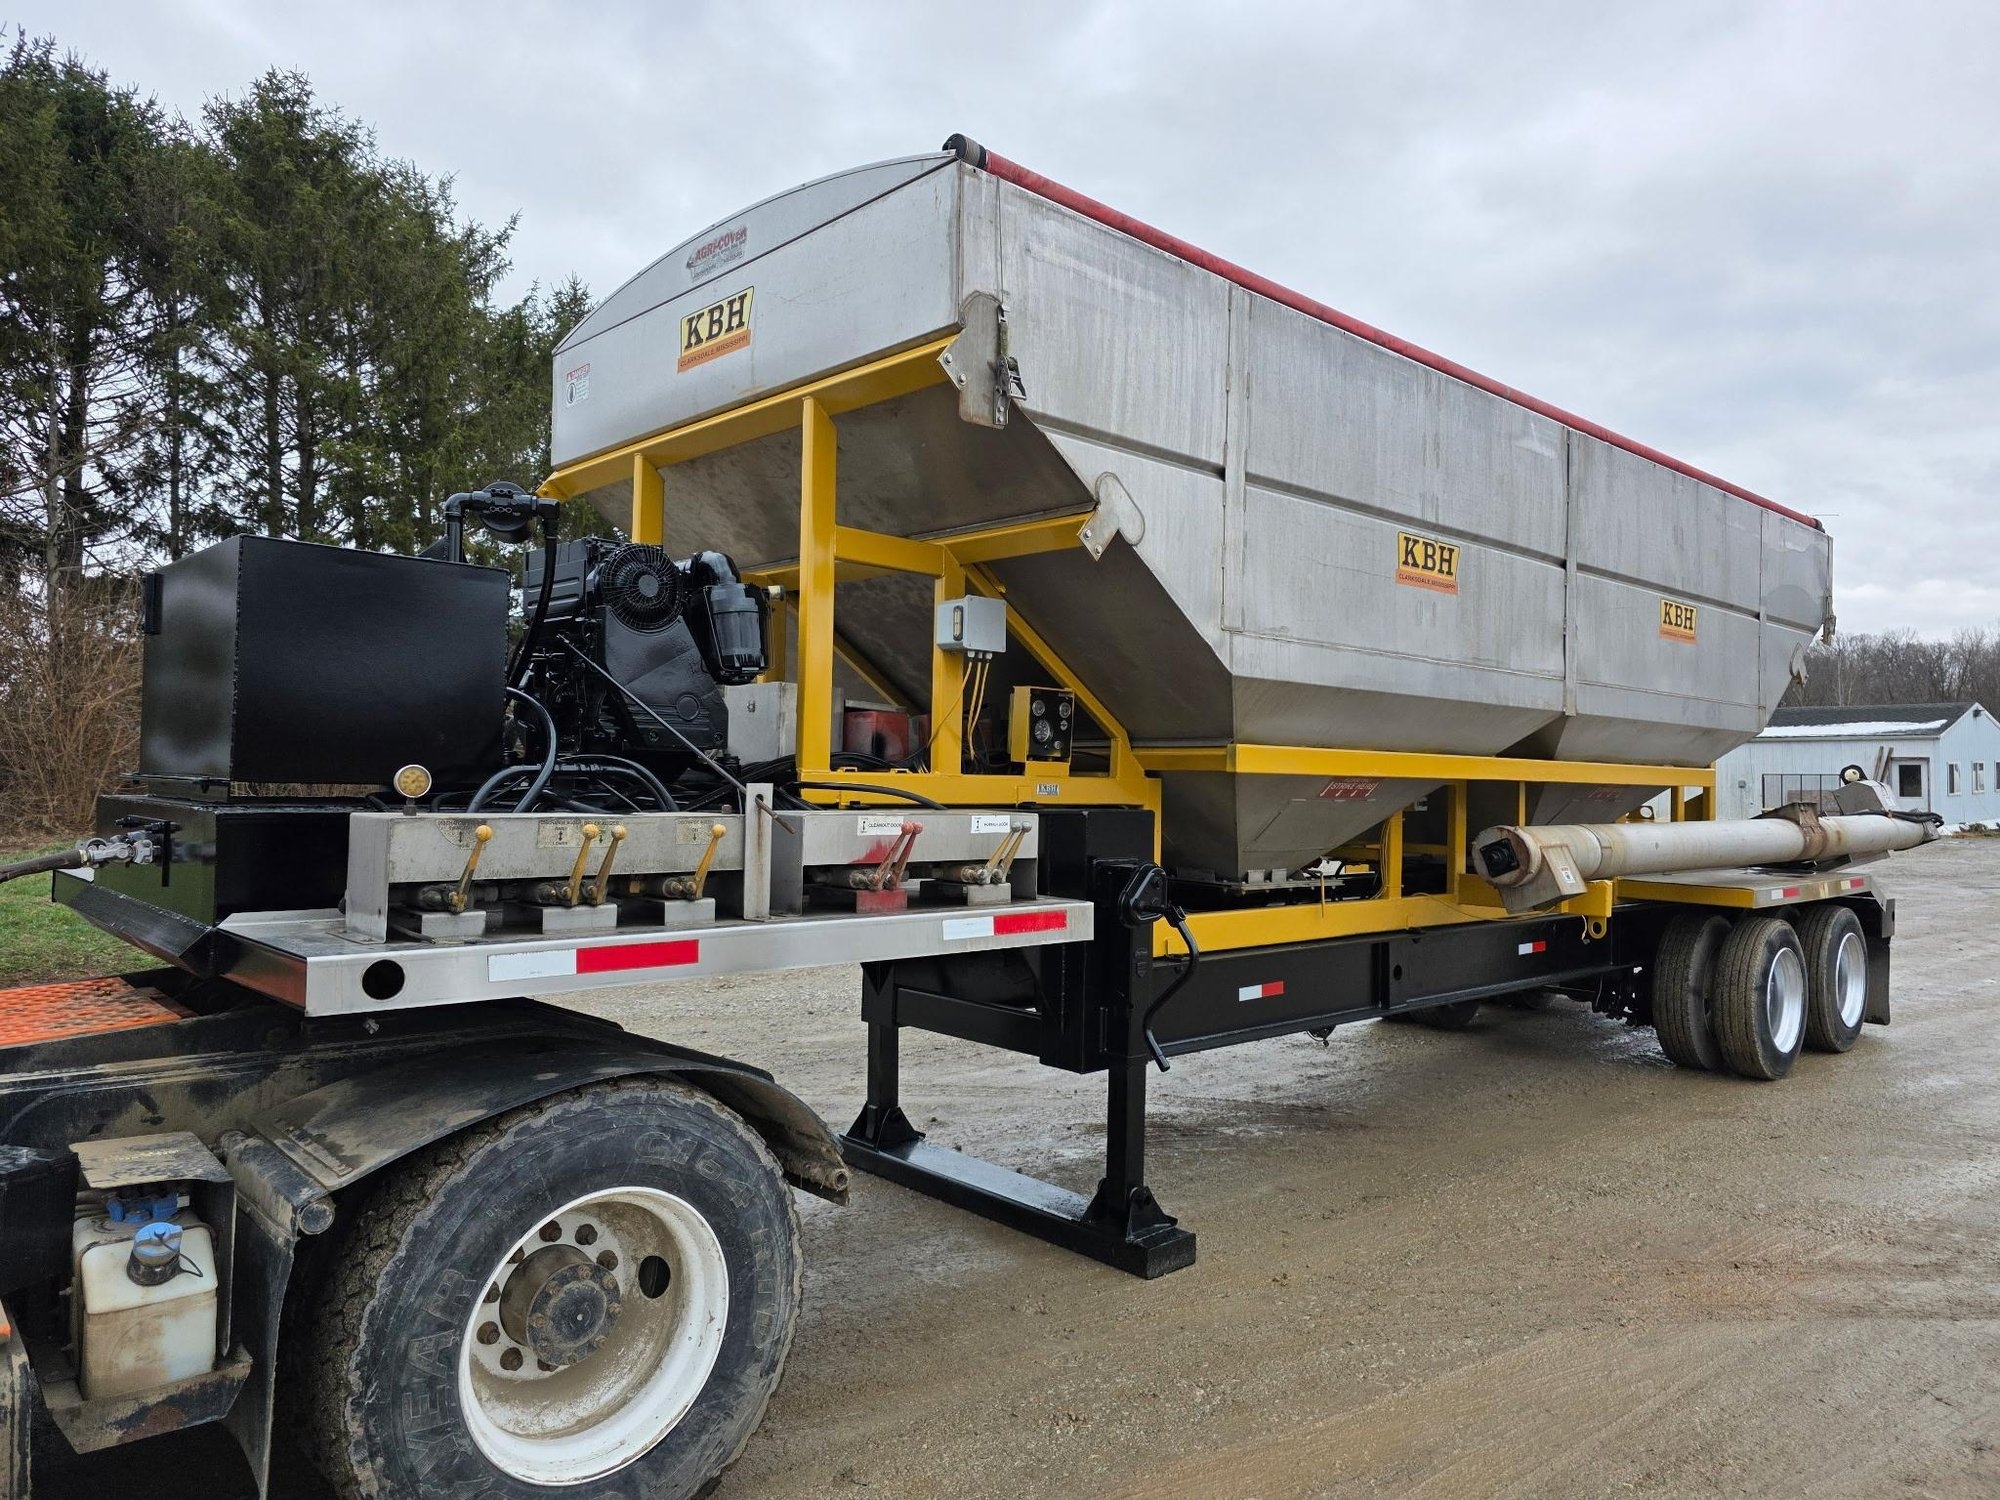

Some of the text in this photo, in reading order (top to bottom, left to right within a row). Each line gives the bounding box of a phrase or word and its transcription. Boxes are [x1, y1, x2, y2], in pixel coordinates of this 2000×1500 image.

[685, 292, 748, 350] KBH
[680, 349, 715, 367] CLARKSDALE
[1402, 536, 1455, 576] KBH
[1399, 573, 1430, 585] CLARKSDALE
[1663, 601, 1694, 630] KBH
